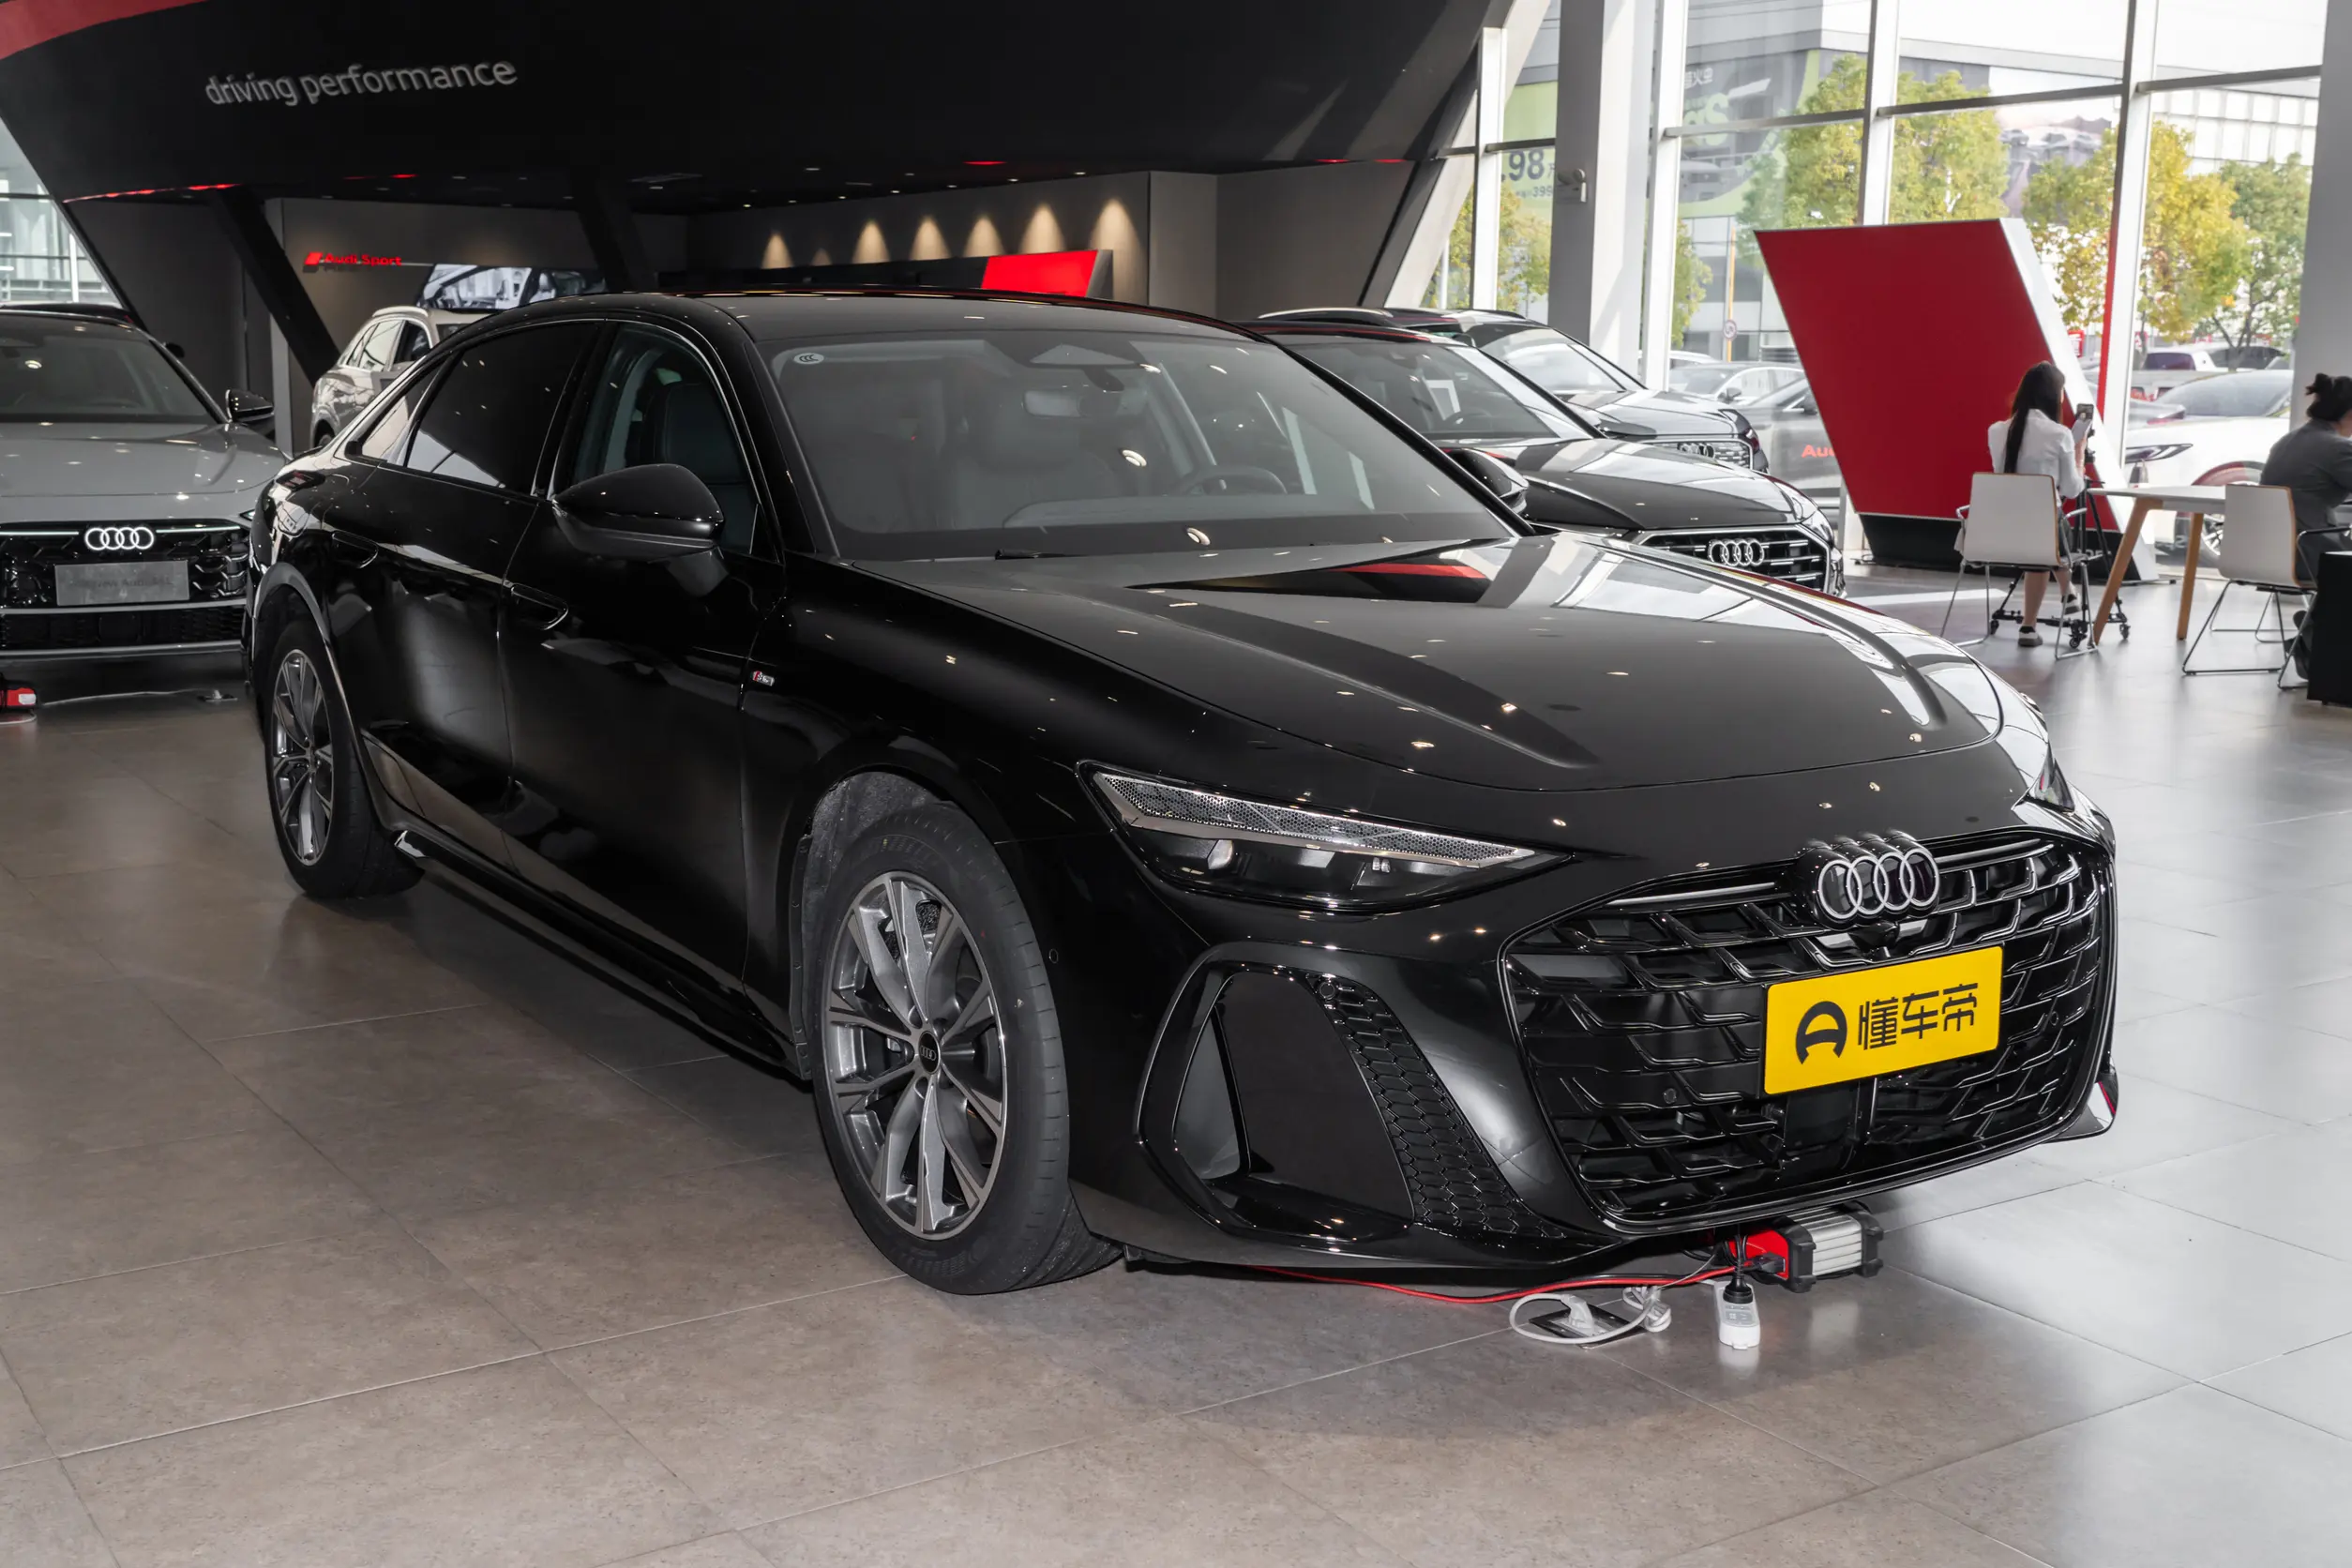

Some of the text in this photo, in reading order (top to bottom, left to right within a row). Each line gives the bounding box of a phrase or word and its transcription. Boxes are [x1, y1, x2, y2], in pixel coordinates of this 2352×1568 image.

[205, 61, 518, 106] driving performance
[324, 252, 401, 266] Audi Sport
[1857, 982, 1979, 1051] 懂车帝
